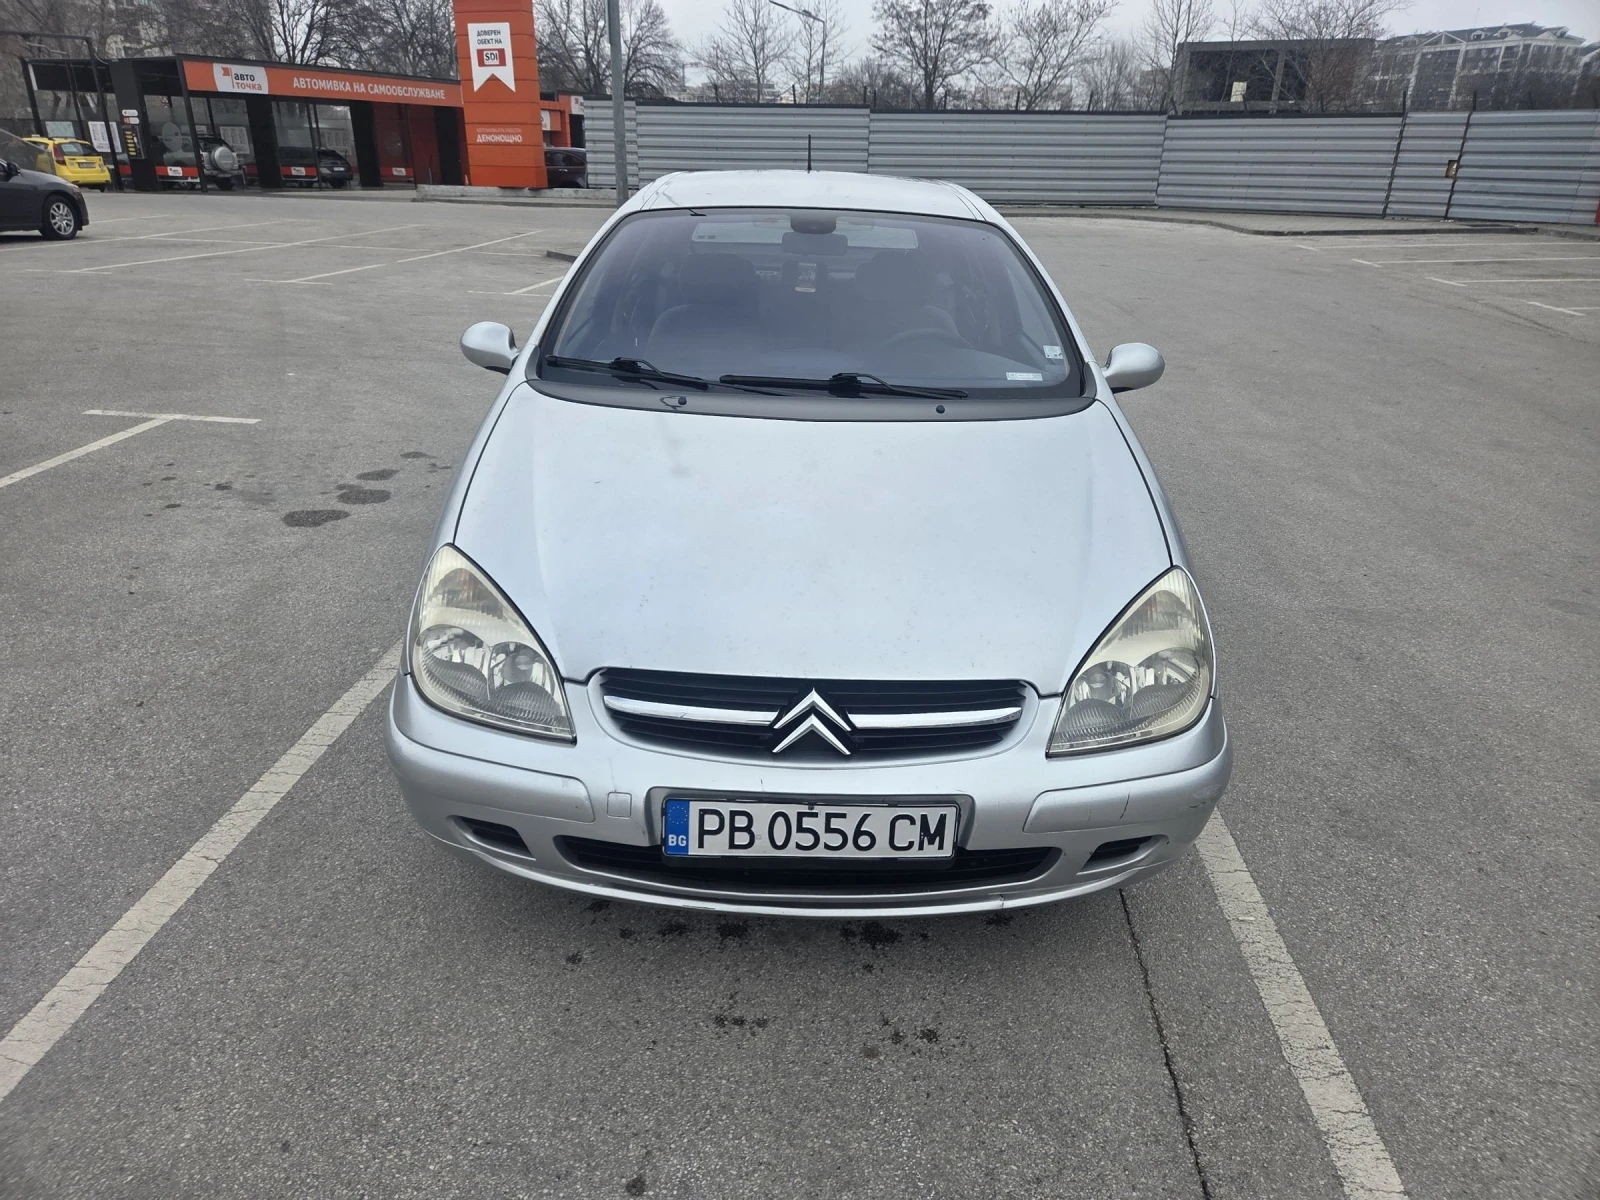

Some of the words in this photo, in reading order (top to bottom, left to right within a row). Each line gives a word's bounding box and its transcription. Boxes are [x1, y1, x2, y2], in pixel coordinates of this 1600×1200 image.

[476, 29, 501, 37] ДОВЕРЕН
[485, 52, 498, 61] SDI
[234, 72, 255, 82] авто
[236, 82, 262, 91] точка
[293, 77, 351, 93] АВТОМИВКА
[354, 82, 366, 94] НА
[368, 84, 446, 100] САМООБСЛУЖВАНЕ
[476, 134, 522, 143] ДЕНОНОЩНО
[697, 808, 756, 850] PB
[767, 810, 877, 852] 0556
[888, 813, 948, 851] CM
[668, 834, 687, 847] BG
